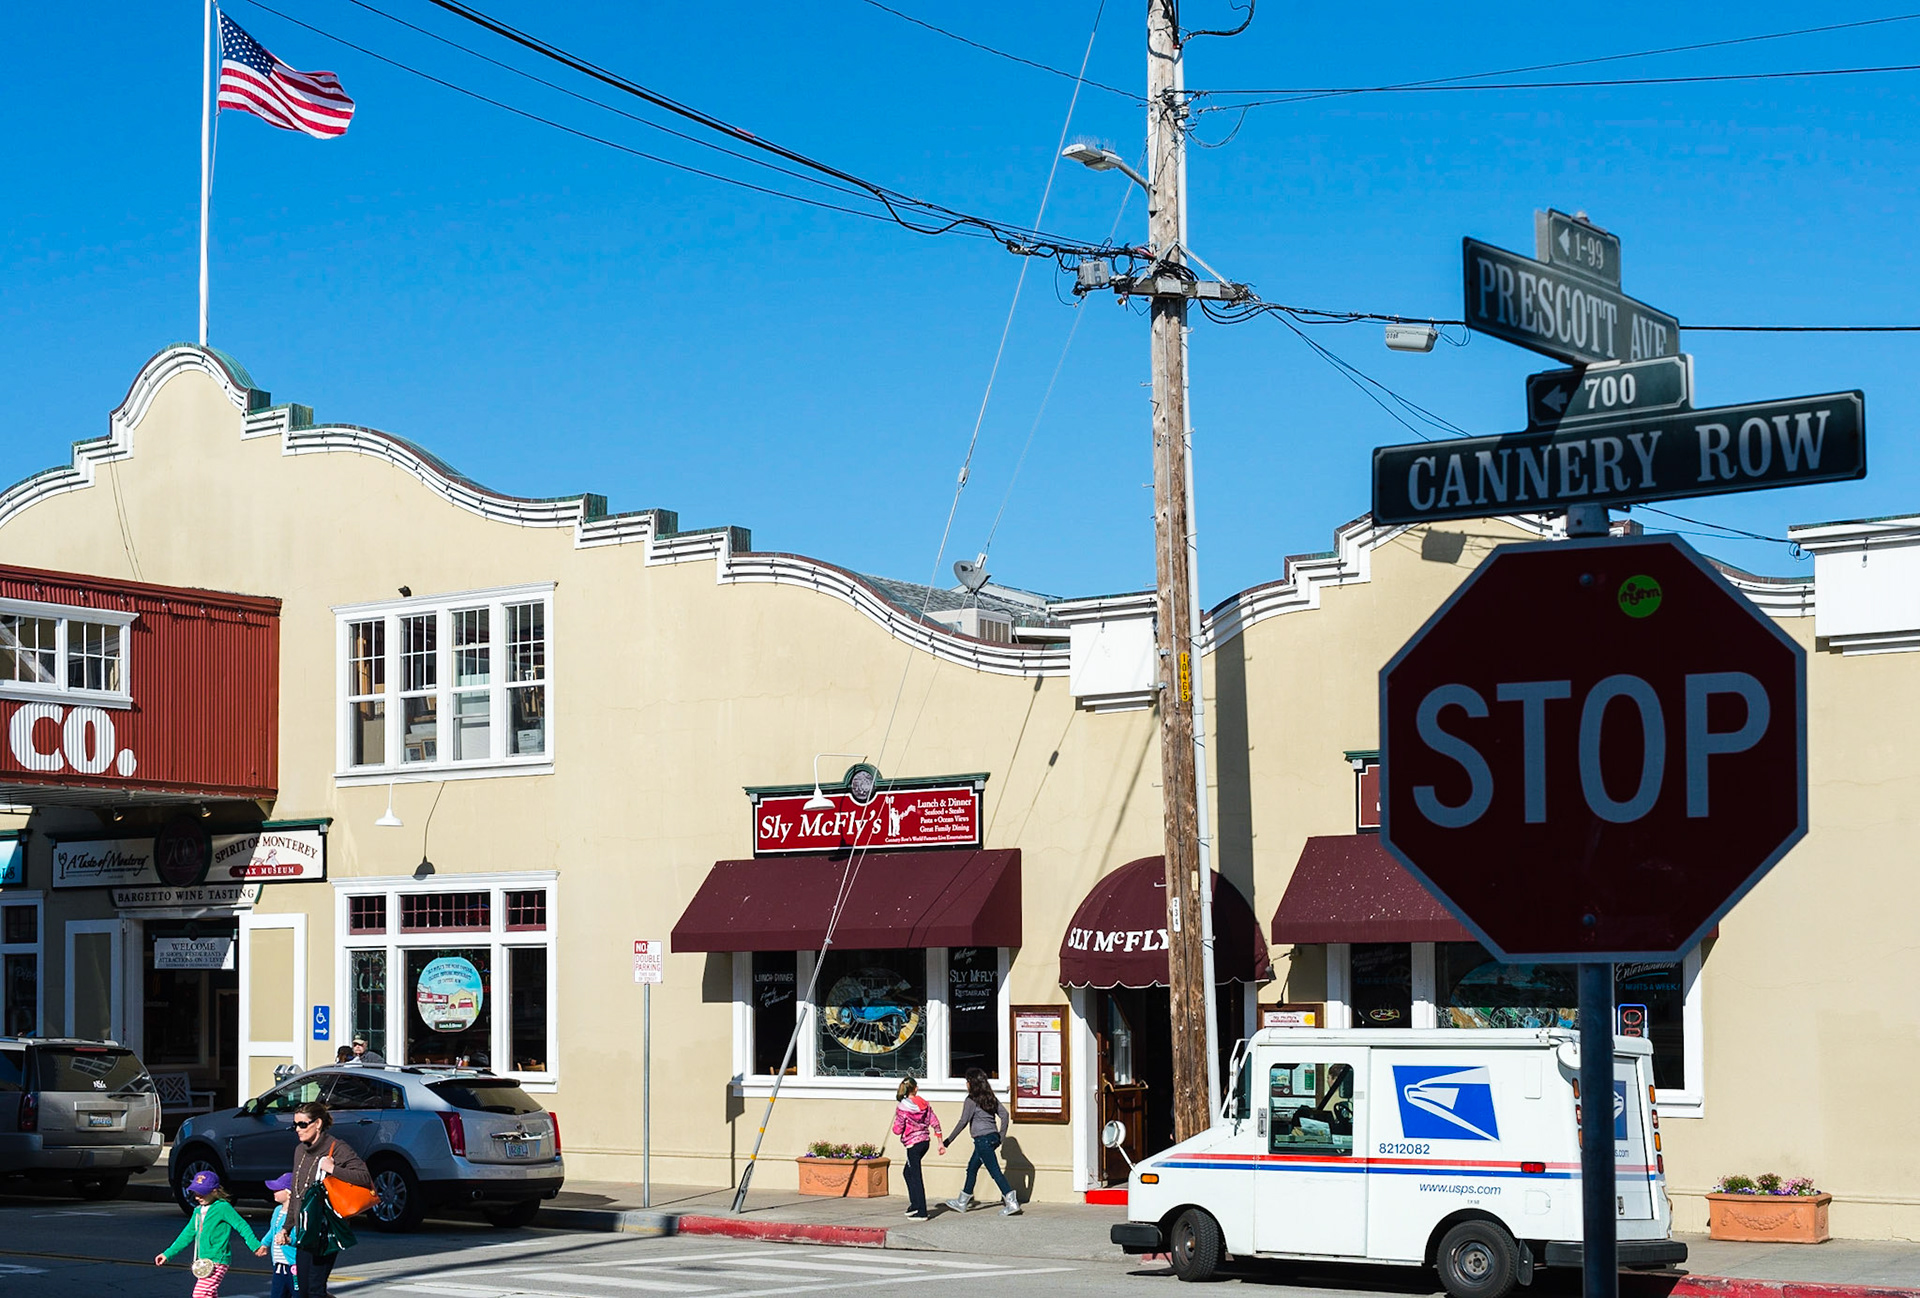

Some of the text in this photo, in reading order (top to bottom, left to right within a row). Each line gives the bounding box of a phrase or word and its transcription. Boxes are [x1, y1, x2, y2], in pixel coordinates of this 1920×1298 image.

[1575, 232, 1604, 270] 1-99
[1477, 256, 1667, 362] PRESCOTT AVE
[1584, 372, 1636, 410] 700
[1408, 409, 1831, 512] CANNERY ROW
[1181, 653, 1189, 701] 10465
[8, 702, 138, 778] CO.
[1412, 671, 1771, 829] STOP
[917, 798, 972, 808] Lunch & Dinner
[760, 809, 882, 843] Sly McFly's
[214, 835, 318, 864] SPIRIT OF MONTEREY
[239, 866, 295, 875] WAX MUSEUM
[117, 888, 255, 903] BARGETTO WINE TASTING
[171, 942, 216, 951] WELCOME
[1068, 927, 1094, 951] SLY
[635, 942, 646, 953] NO
[635, 955, 661, 963] DOUBLE
[635, 963, 661, 972] PARKING
[949, 969, 968, 983] SLY
[1625, 983, 1649, 991] NIGHTS
[1378, 1143, 1430, 1155] 8212082
[1419, 1183, 1502, 1196] www.usps.com
